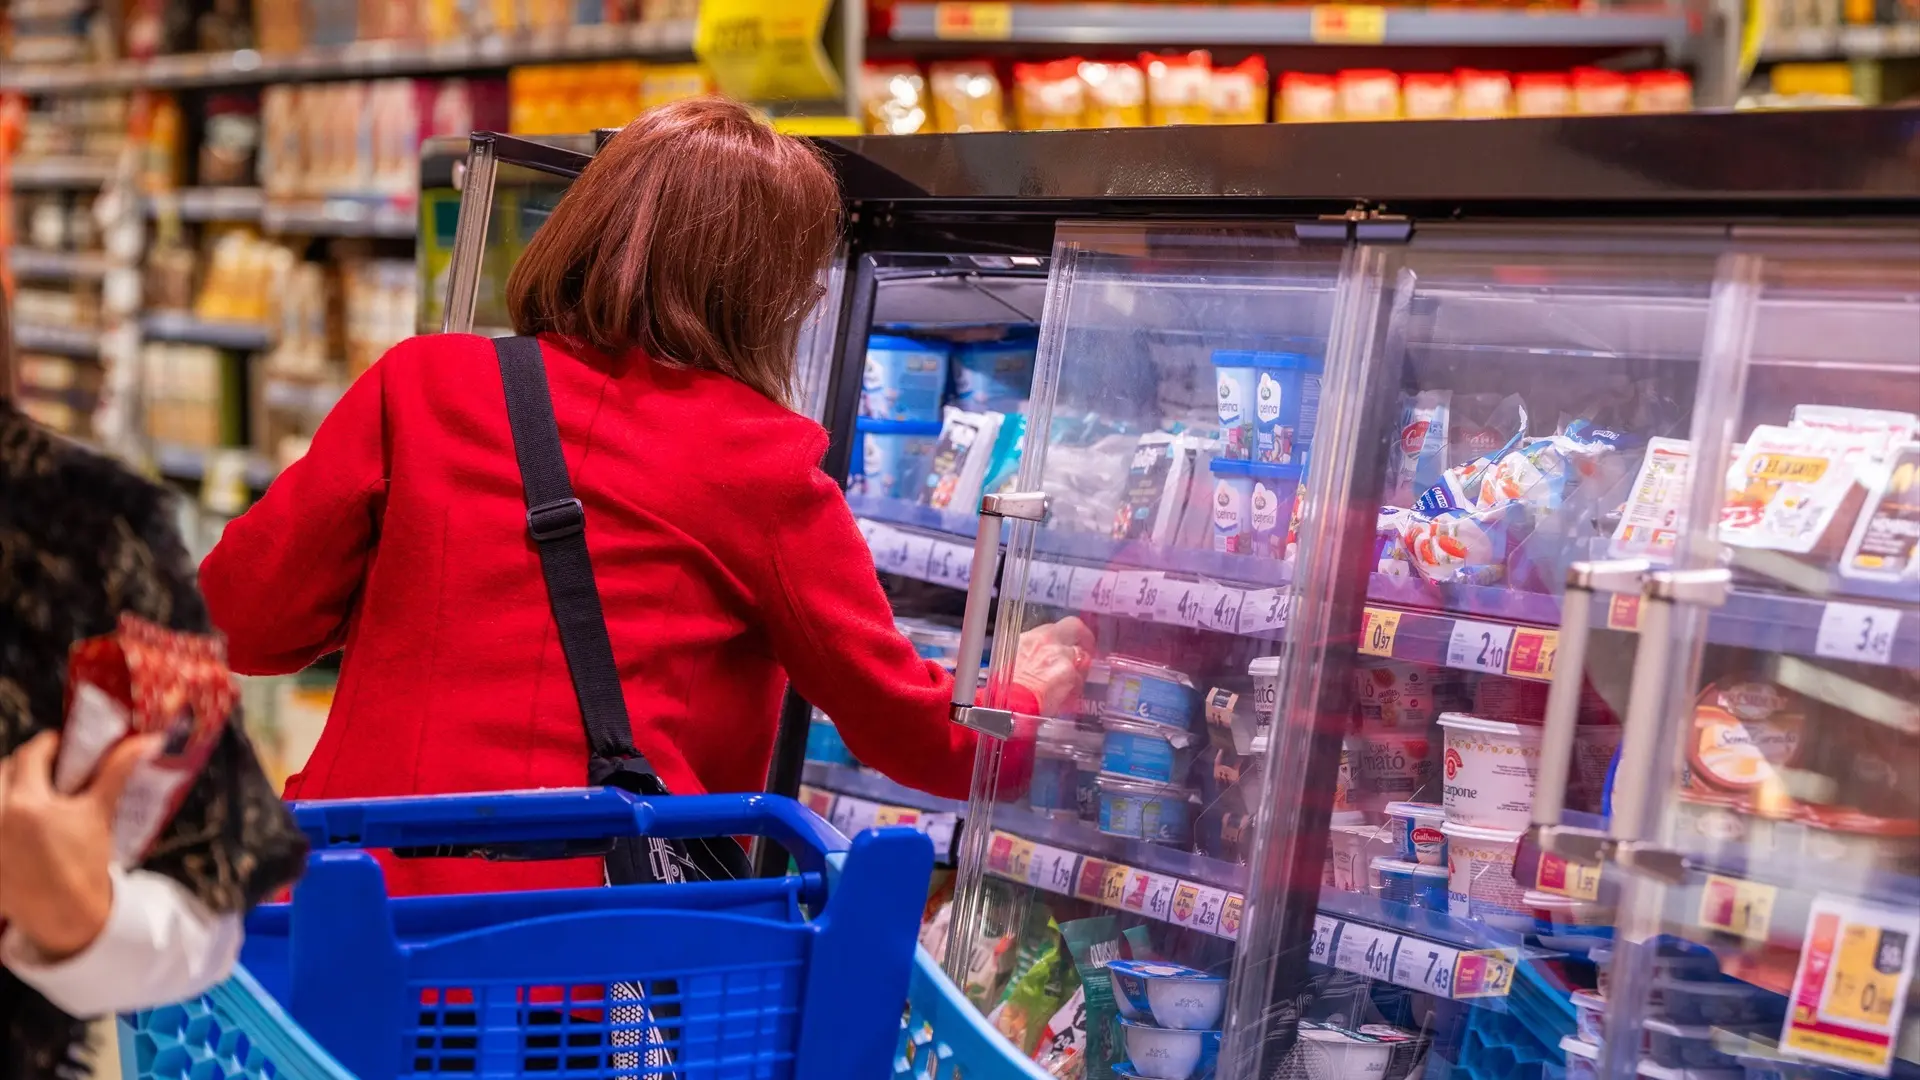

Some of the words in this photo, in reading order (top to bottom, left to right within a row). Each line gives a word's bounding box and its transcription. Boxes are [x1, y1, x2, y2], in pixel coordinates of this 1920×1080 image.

[1177, 589, 1198, 621] 4,17
[1213, 593, 1235, 626] 4,17
[1372, 623, 1391, 650] 0,97
[1476, 631, 1504, 669] 2,10
[1413, 831, 1442, 843] Galbani
[1051, 855, 1070, 889] 1,79
[1150, 889, 1166, 914] 4,31
[1199, 901, 1215, 926] 2,39
[1365, 937, 1389, 974] 4,01
[1423, 951, 1450, 990] 7,43
